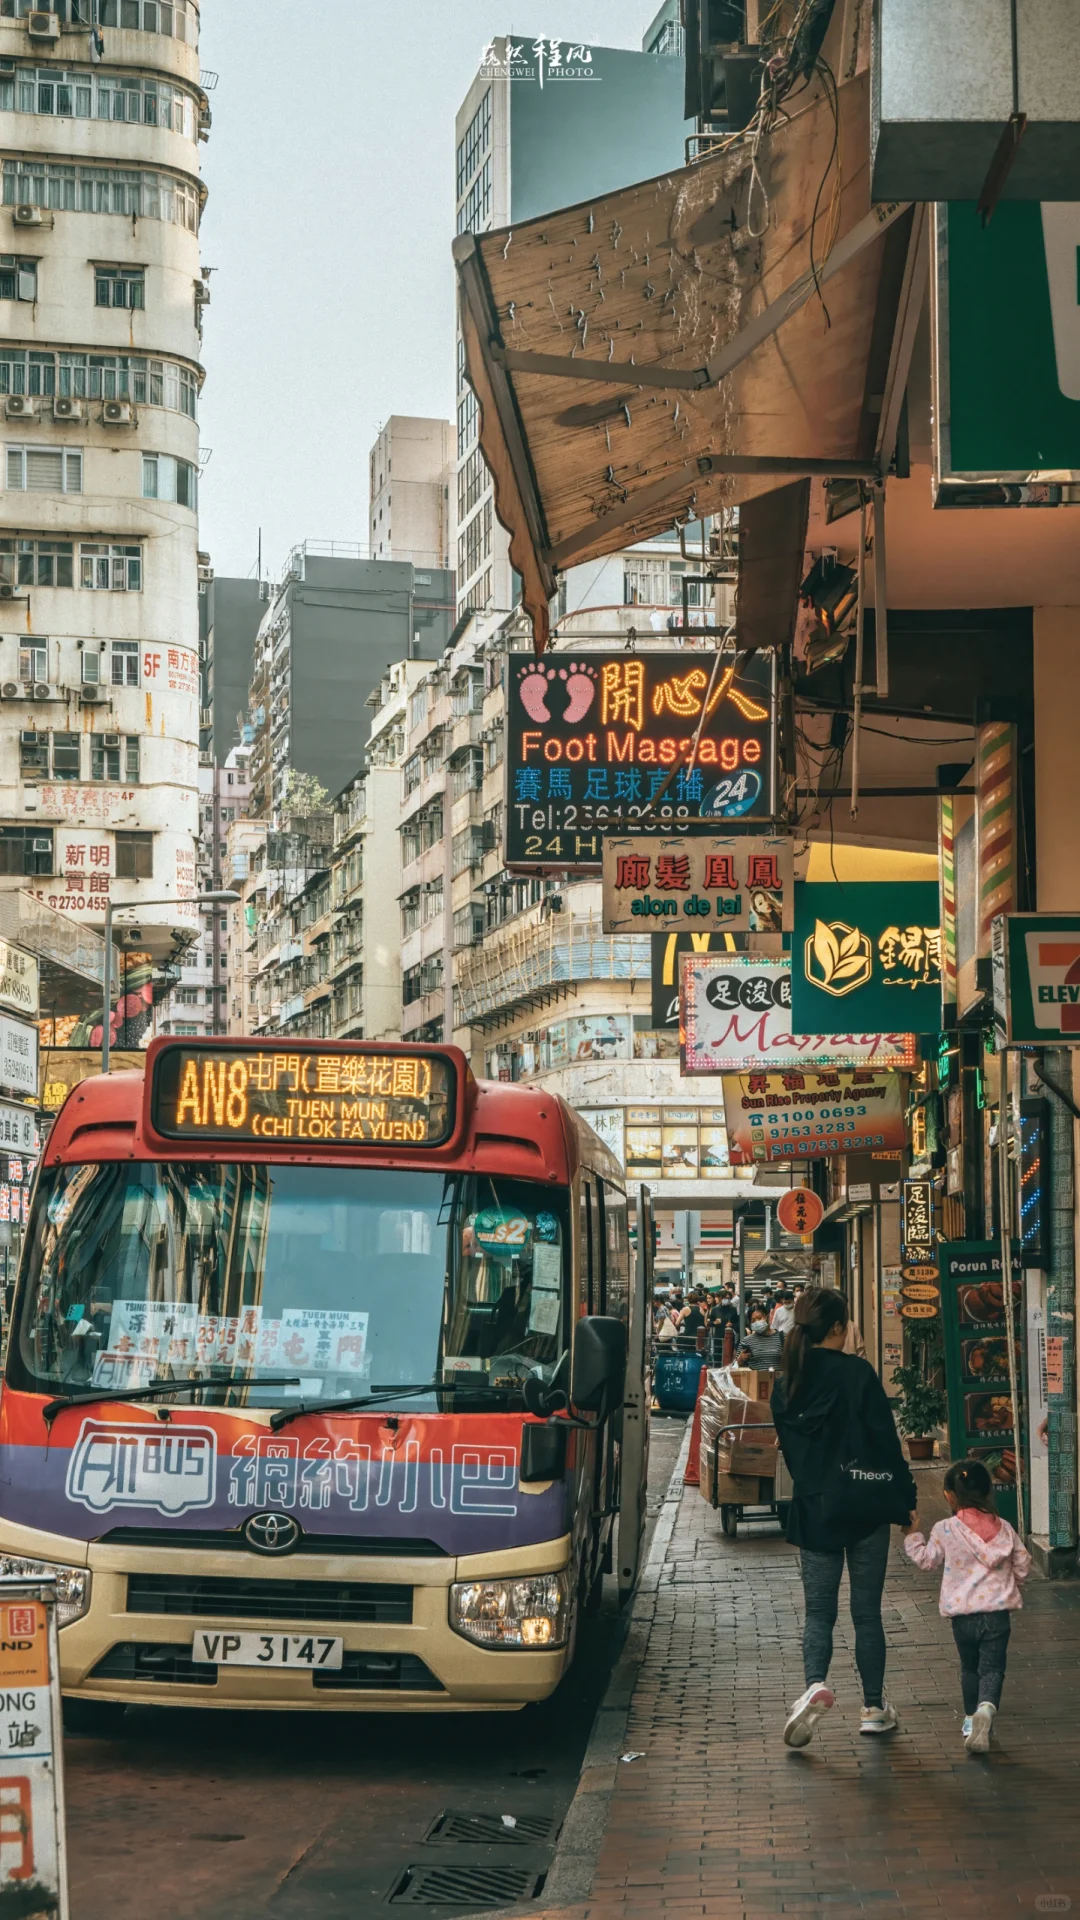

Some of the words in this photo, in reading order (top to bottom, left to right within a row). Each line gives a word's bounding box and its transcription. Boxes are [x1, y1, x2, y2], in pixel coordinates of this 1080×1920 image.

[144, 653, 161, 678] 5F
[602, 660, 769, 732] 開心人
[522, 732, 597, 762] Foot
[713, 774, 748, 808] 24
[65, 844, 111, 867] 新明
[525, 836, 564, 856] 24
[65, 870, 111, 893] 賓館
[58, 896, 86, 910] 2730
[683, 894, 711, 916] de
[882, 971, 942, 990] ceylo
[176, 1059, 248, 1128] AN8
[741, 1096, 765, 1109] Sun
[766, 1094, 791, 1108] Rise
[793, 1088, 842, 1105] Property
[844, 1085, 887, 1101] Agency
[287, 1099, 334, 1119] TUEN
[341, 1102, 385, 1120] MUN
[667, 1111, 695, 1120] Enquiry
[768, 1110, 813, 1125] 8100
[820, 1105, 867, 1120] 0693
[252, 1117, 292, 1136] (CHI
[299, 1119, 335, 1138] LOK
[342, 1120, 362, 1138] FA
[370, 1119, 426, 1141] YUEN)
[770, 1125, 813, 1139] 9753
[815, 1121, 856, 1136] 3283
[771, 1141, 796, 1156] SR
[798, 1139, 839, 1153] 9753
[843, 1134, 885, 1149] 3283
[908, 1186, 930, 1242] 足浚臨
[950, 1260, 988, 1273] Porun
[125, 1302, 147, 1312] TSING
[302, 1311, 326, 1320] TUEN
[329, 1312, 350, 1321] MUN
[198, 1327, 215, 1344] 23
[219, 1327, 237, 1345] 15
[261, 1330, 278, 1347] 25
[228, 1434, 518, 1517] 網約小巴
[850, 1469, 893, 1481] Theory
[203, 1635, 241, 1660] VP
[256, 1636, 336, 1664] 3147
